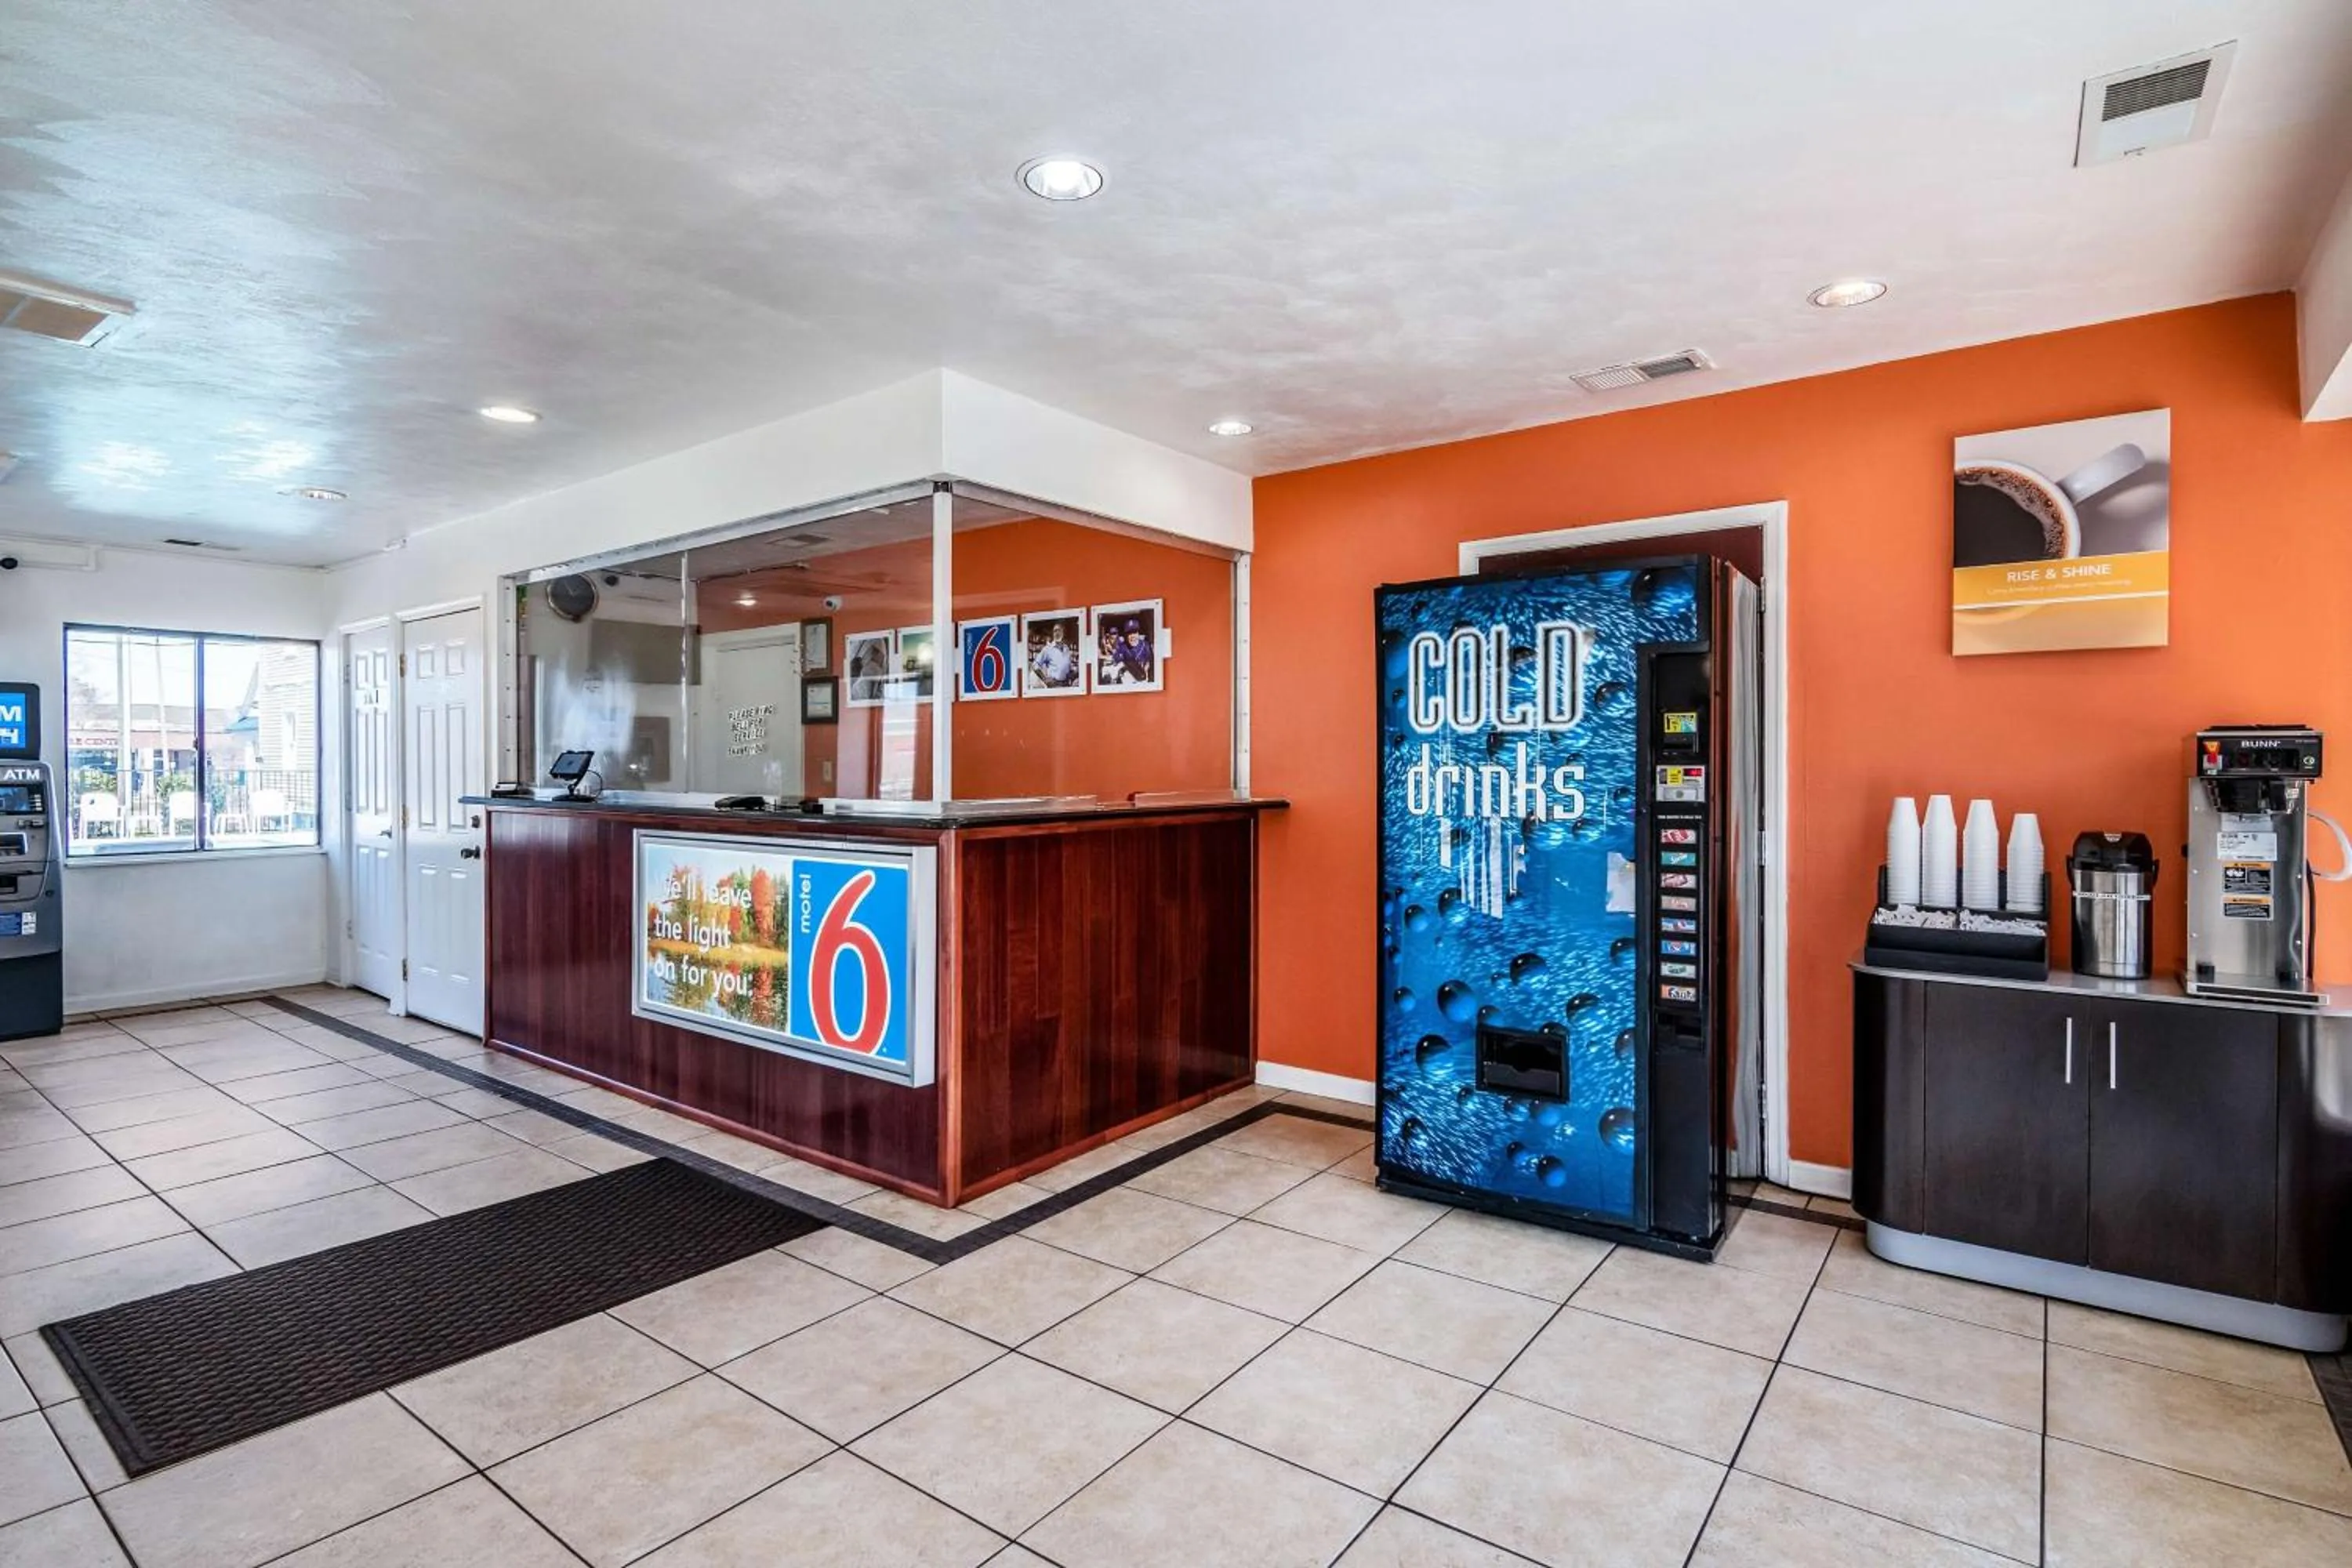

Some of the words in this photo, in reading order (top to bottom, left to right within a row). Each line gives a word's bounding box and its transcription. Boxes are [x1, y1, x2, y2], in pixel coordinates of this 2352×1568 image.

[2007, 570, 2039, 583] RISE
[2045, 568, 2056, 579] &
[2062, 564, 2111, 578] SHINE
[971, 626, 1005, 693] 6
[1408, 621, 1584, 733] COLD
[3, 769, 40, 781] ATM
[1407, 741, 1584, 822] drinks
[654, 911, 681, 939] the
[689, 915, 731, 953] light
[800, 874, 811, 934] motel
[654, 959, 675, 981] on
[681, 954, 708, 987] for
[808, 869, 891, 1055] 6
